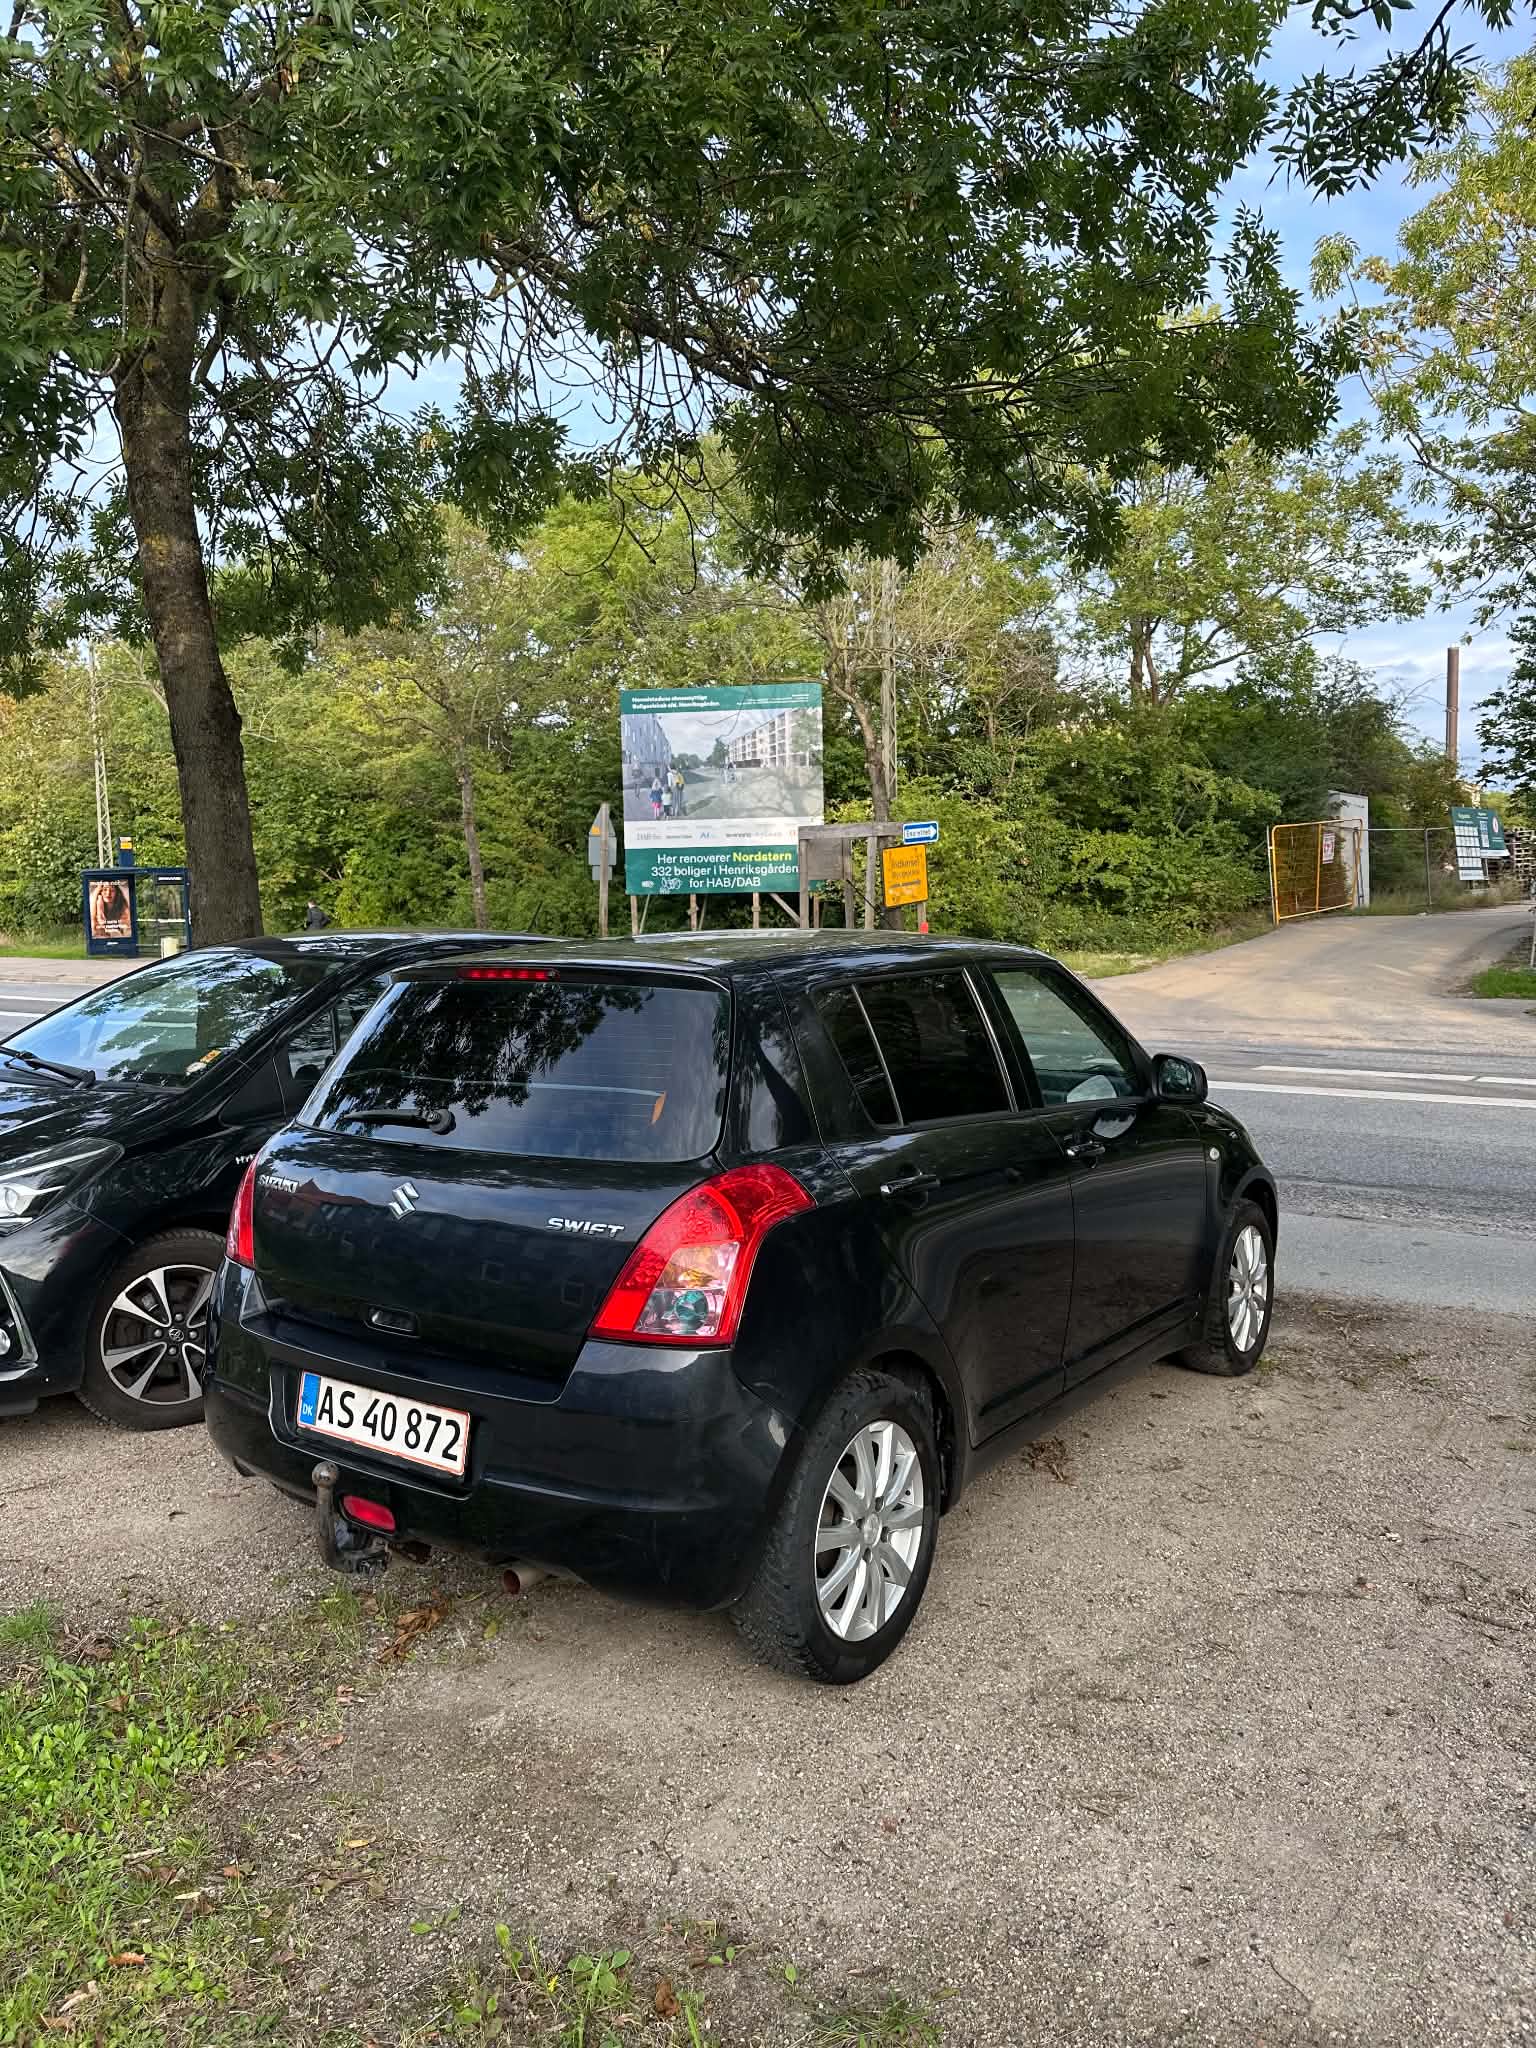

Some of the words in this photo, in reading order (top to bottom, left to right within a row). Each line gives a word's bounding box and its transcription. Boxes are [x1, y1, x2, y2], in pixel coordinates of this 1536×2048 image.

[657, 854, 676, 864] Her
[679, 854, 731, 864] renoverer
[732, 852, 792, 862] Nordstern
[651, 866, 672, 877] 332
[674, 865, 711, 878] boliger
[719, 863, 799, 877] Henriksgården
[689, 877, 704, 888] for
[706, 877, 761, 888] HAB/DAB
[259, 1174, 299, 1193] SUZUKI
[545, 1217, 625, 1238] SWIFT
[302, 1403, 313, 1417] DK
[317, 1385, 356, 1429] AS
[362, 1398, 397, 1442] 40
[404, 1408, 461, 1462] 872
